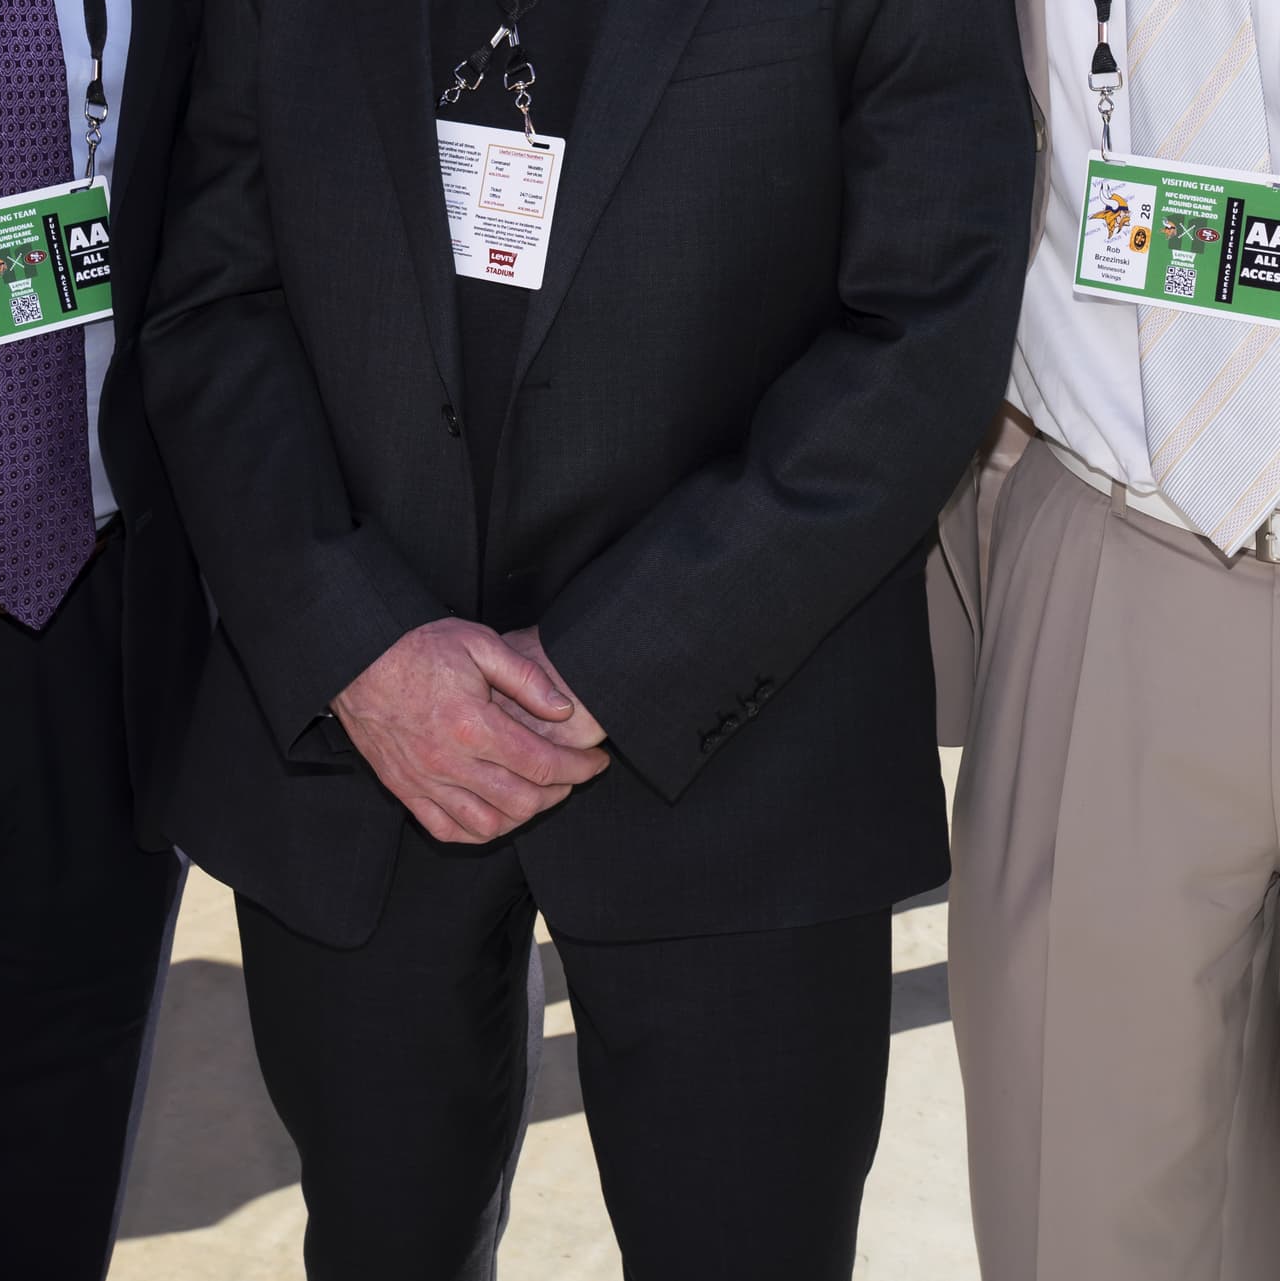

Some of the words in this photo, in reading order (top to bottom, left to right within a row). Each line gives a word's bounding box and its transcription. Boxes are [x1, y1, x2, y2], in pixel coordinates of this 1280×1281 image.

[1161, 177, 1198, 190] VISITING
[1200, 182, 1224, 193] TEAM
[1165, 191, 1178, 199] NFC
[1178, 193, 1217, 205] DIVISIONAL
[1168, 199, 1193, 208] ROUND
[1193, 202, 1213, 211] GAME
[13, 208, 37, 220] TEAM
[1140, 203, 1152, 220] 28
[1161, 206, 1192, 216] JANUARY
[1231, 202, 1239, 226] FULL
[13, 230, 32, 239] GAME
[70, 222, 110, 251] AA
[1106, 245, 1121, 254] Rob
[1226, 229, 1236, 260] FIELD
[48, 218, 56, 240] FULL
[53, 243, 64, 272] FIELD
[61, 274, 72, 309] ACCESS
[83, 252, 104, 266] ALL
[1094, 253, 1130, 265] Brzezinski
[1254, 254, 1279, 268] ALL
[75, 265, 111, 282] ACCES
[486, 266, 515, 277] STADIUM
[1097, 263, 1126, 274] Minnesota
[1101, 272, 1122, 281] Vikings
[1221, 263, 1231, 300] ACCESS
